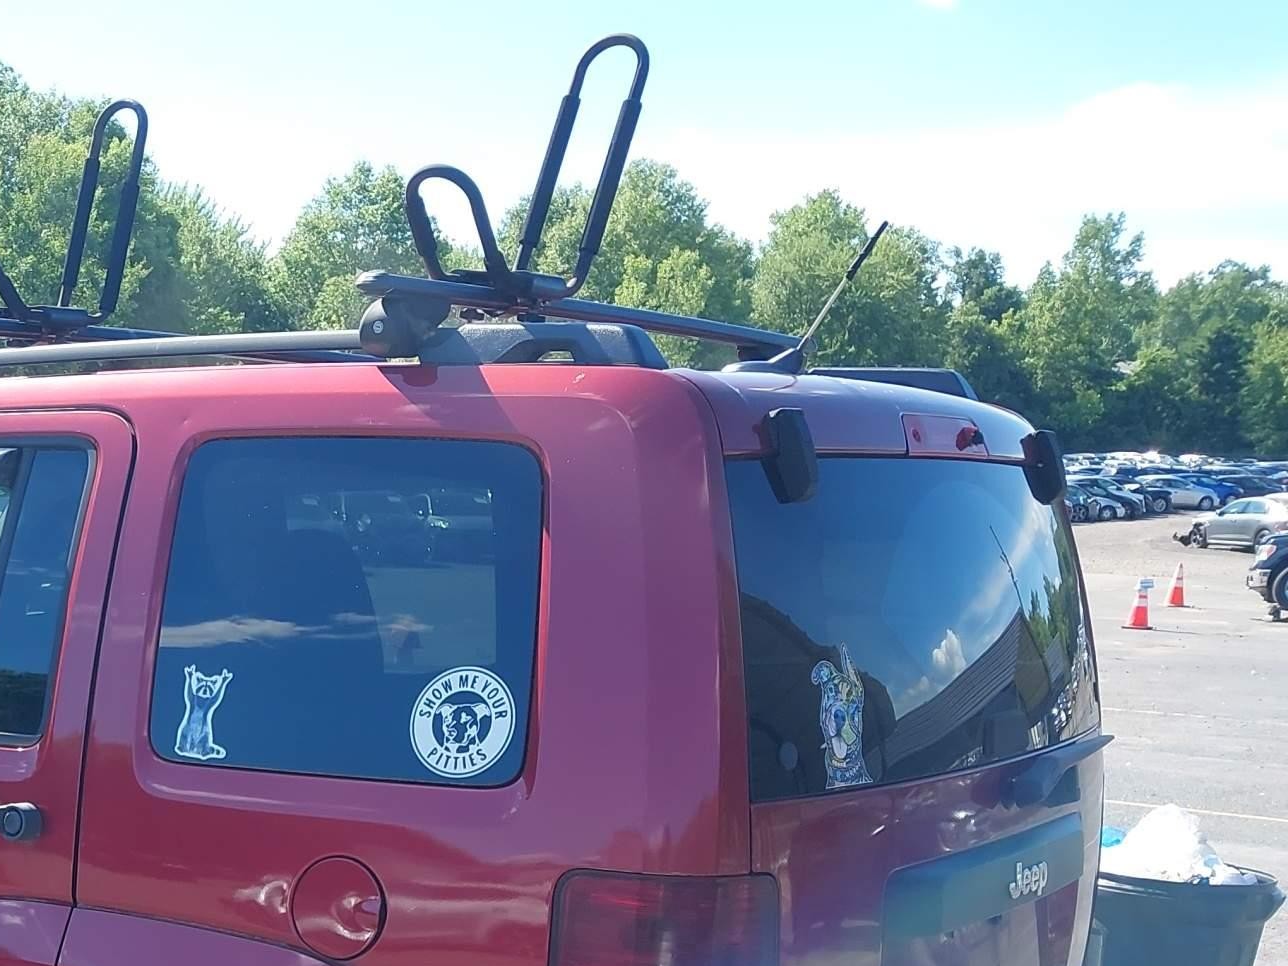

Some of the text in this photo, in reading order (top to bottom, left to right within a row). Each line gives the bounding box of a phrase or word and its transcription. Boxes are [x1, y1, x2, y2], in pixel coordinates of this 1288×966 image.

[419, 673, 509, 720] SHOW ME YOUR
[426, 747, 488, 771] PITTIES
[1008, 861, 1048, 899] Jeep
